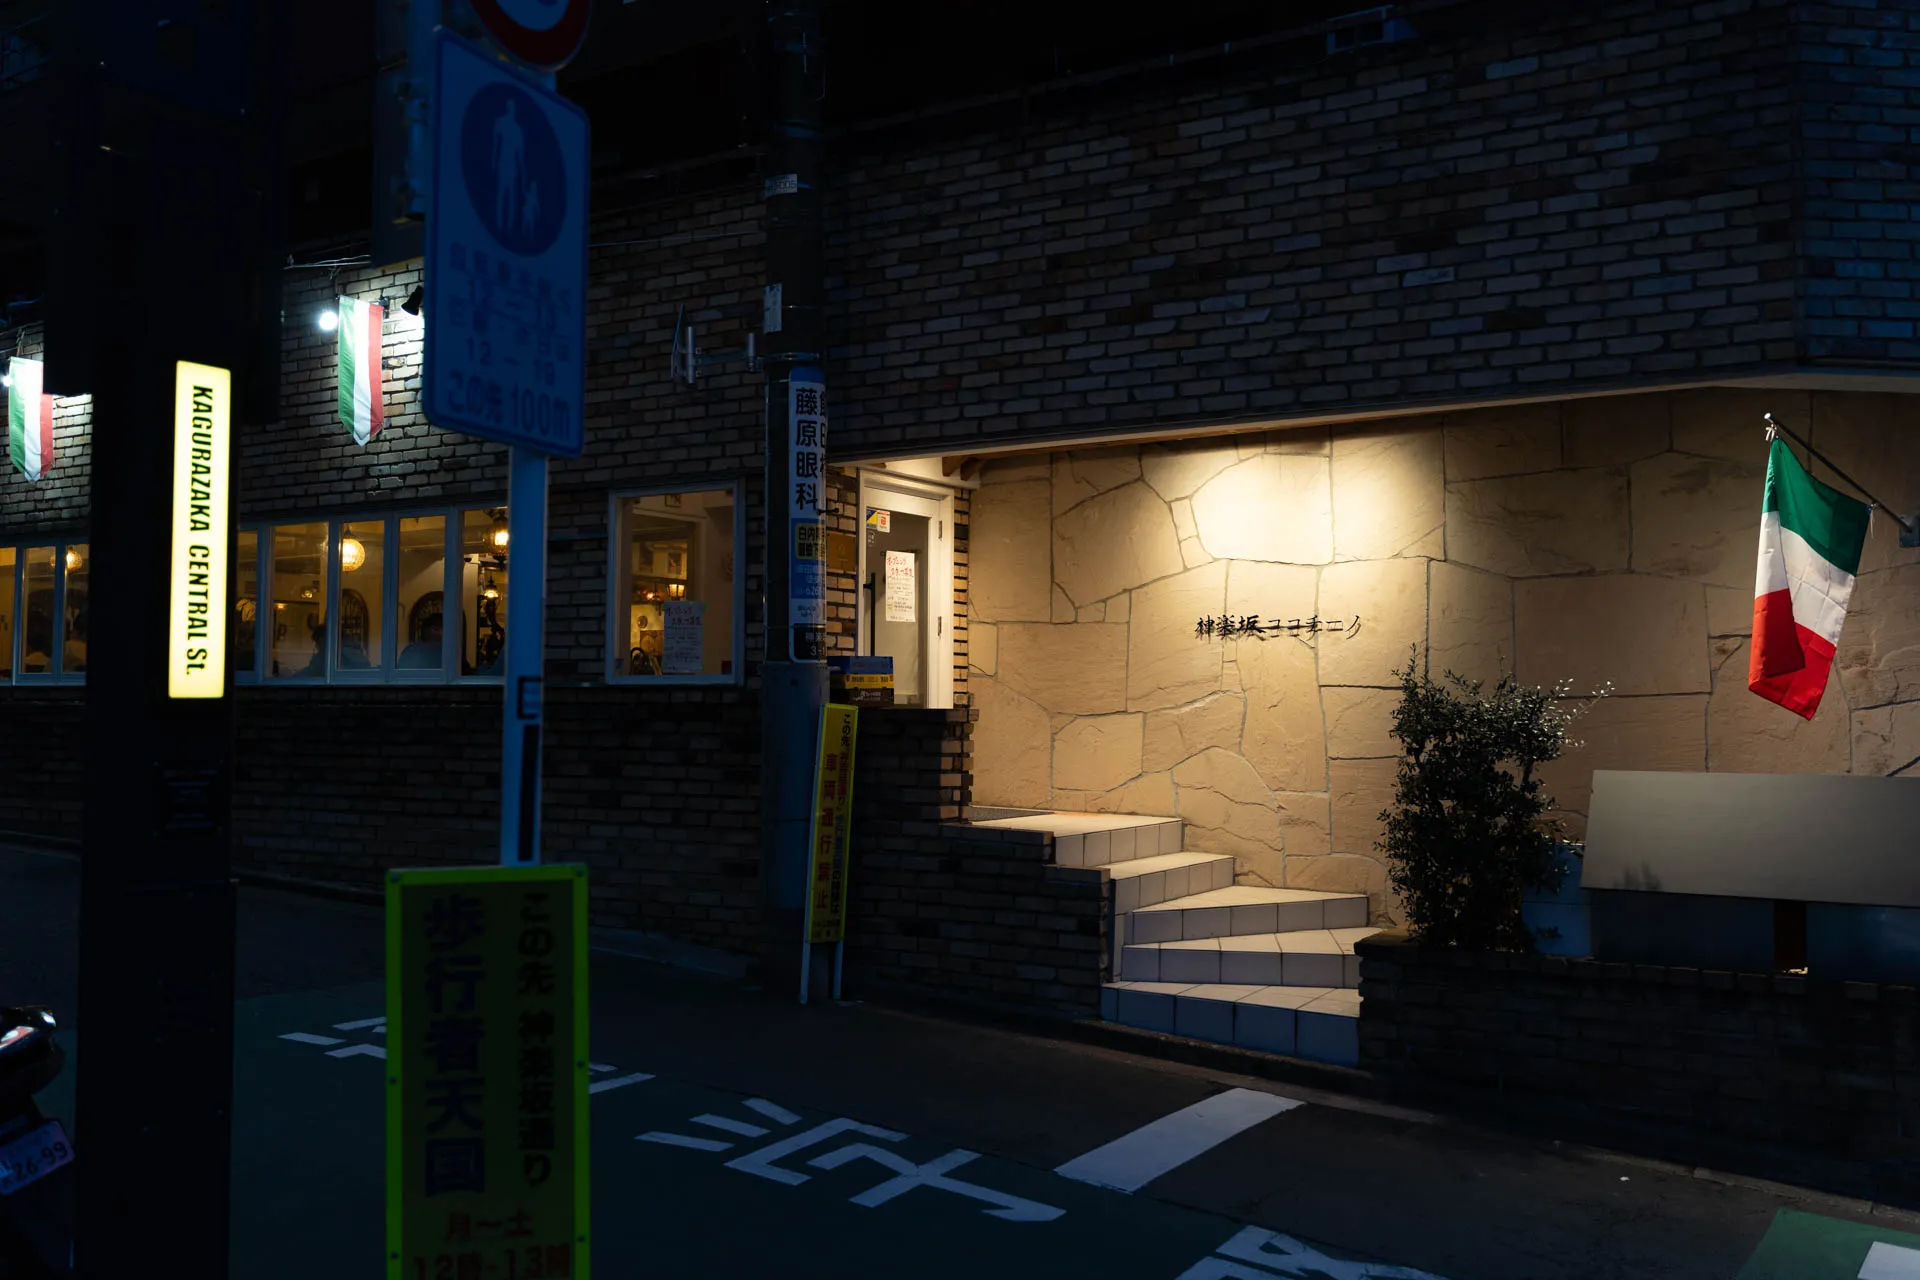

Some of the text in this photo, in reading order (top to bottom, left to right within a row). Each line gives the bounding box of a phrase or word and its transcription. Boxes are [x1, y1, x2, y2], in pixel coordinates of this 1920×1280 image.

[186, 385, 214, 676] KAGURAZAKA CENTRAL St.
[795, 387, 818, 511] 藤原眼科
[425, 893, 486, 1199] 歩行者天国
[518, 893, 555, 995] この先
